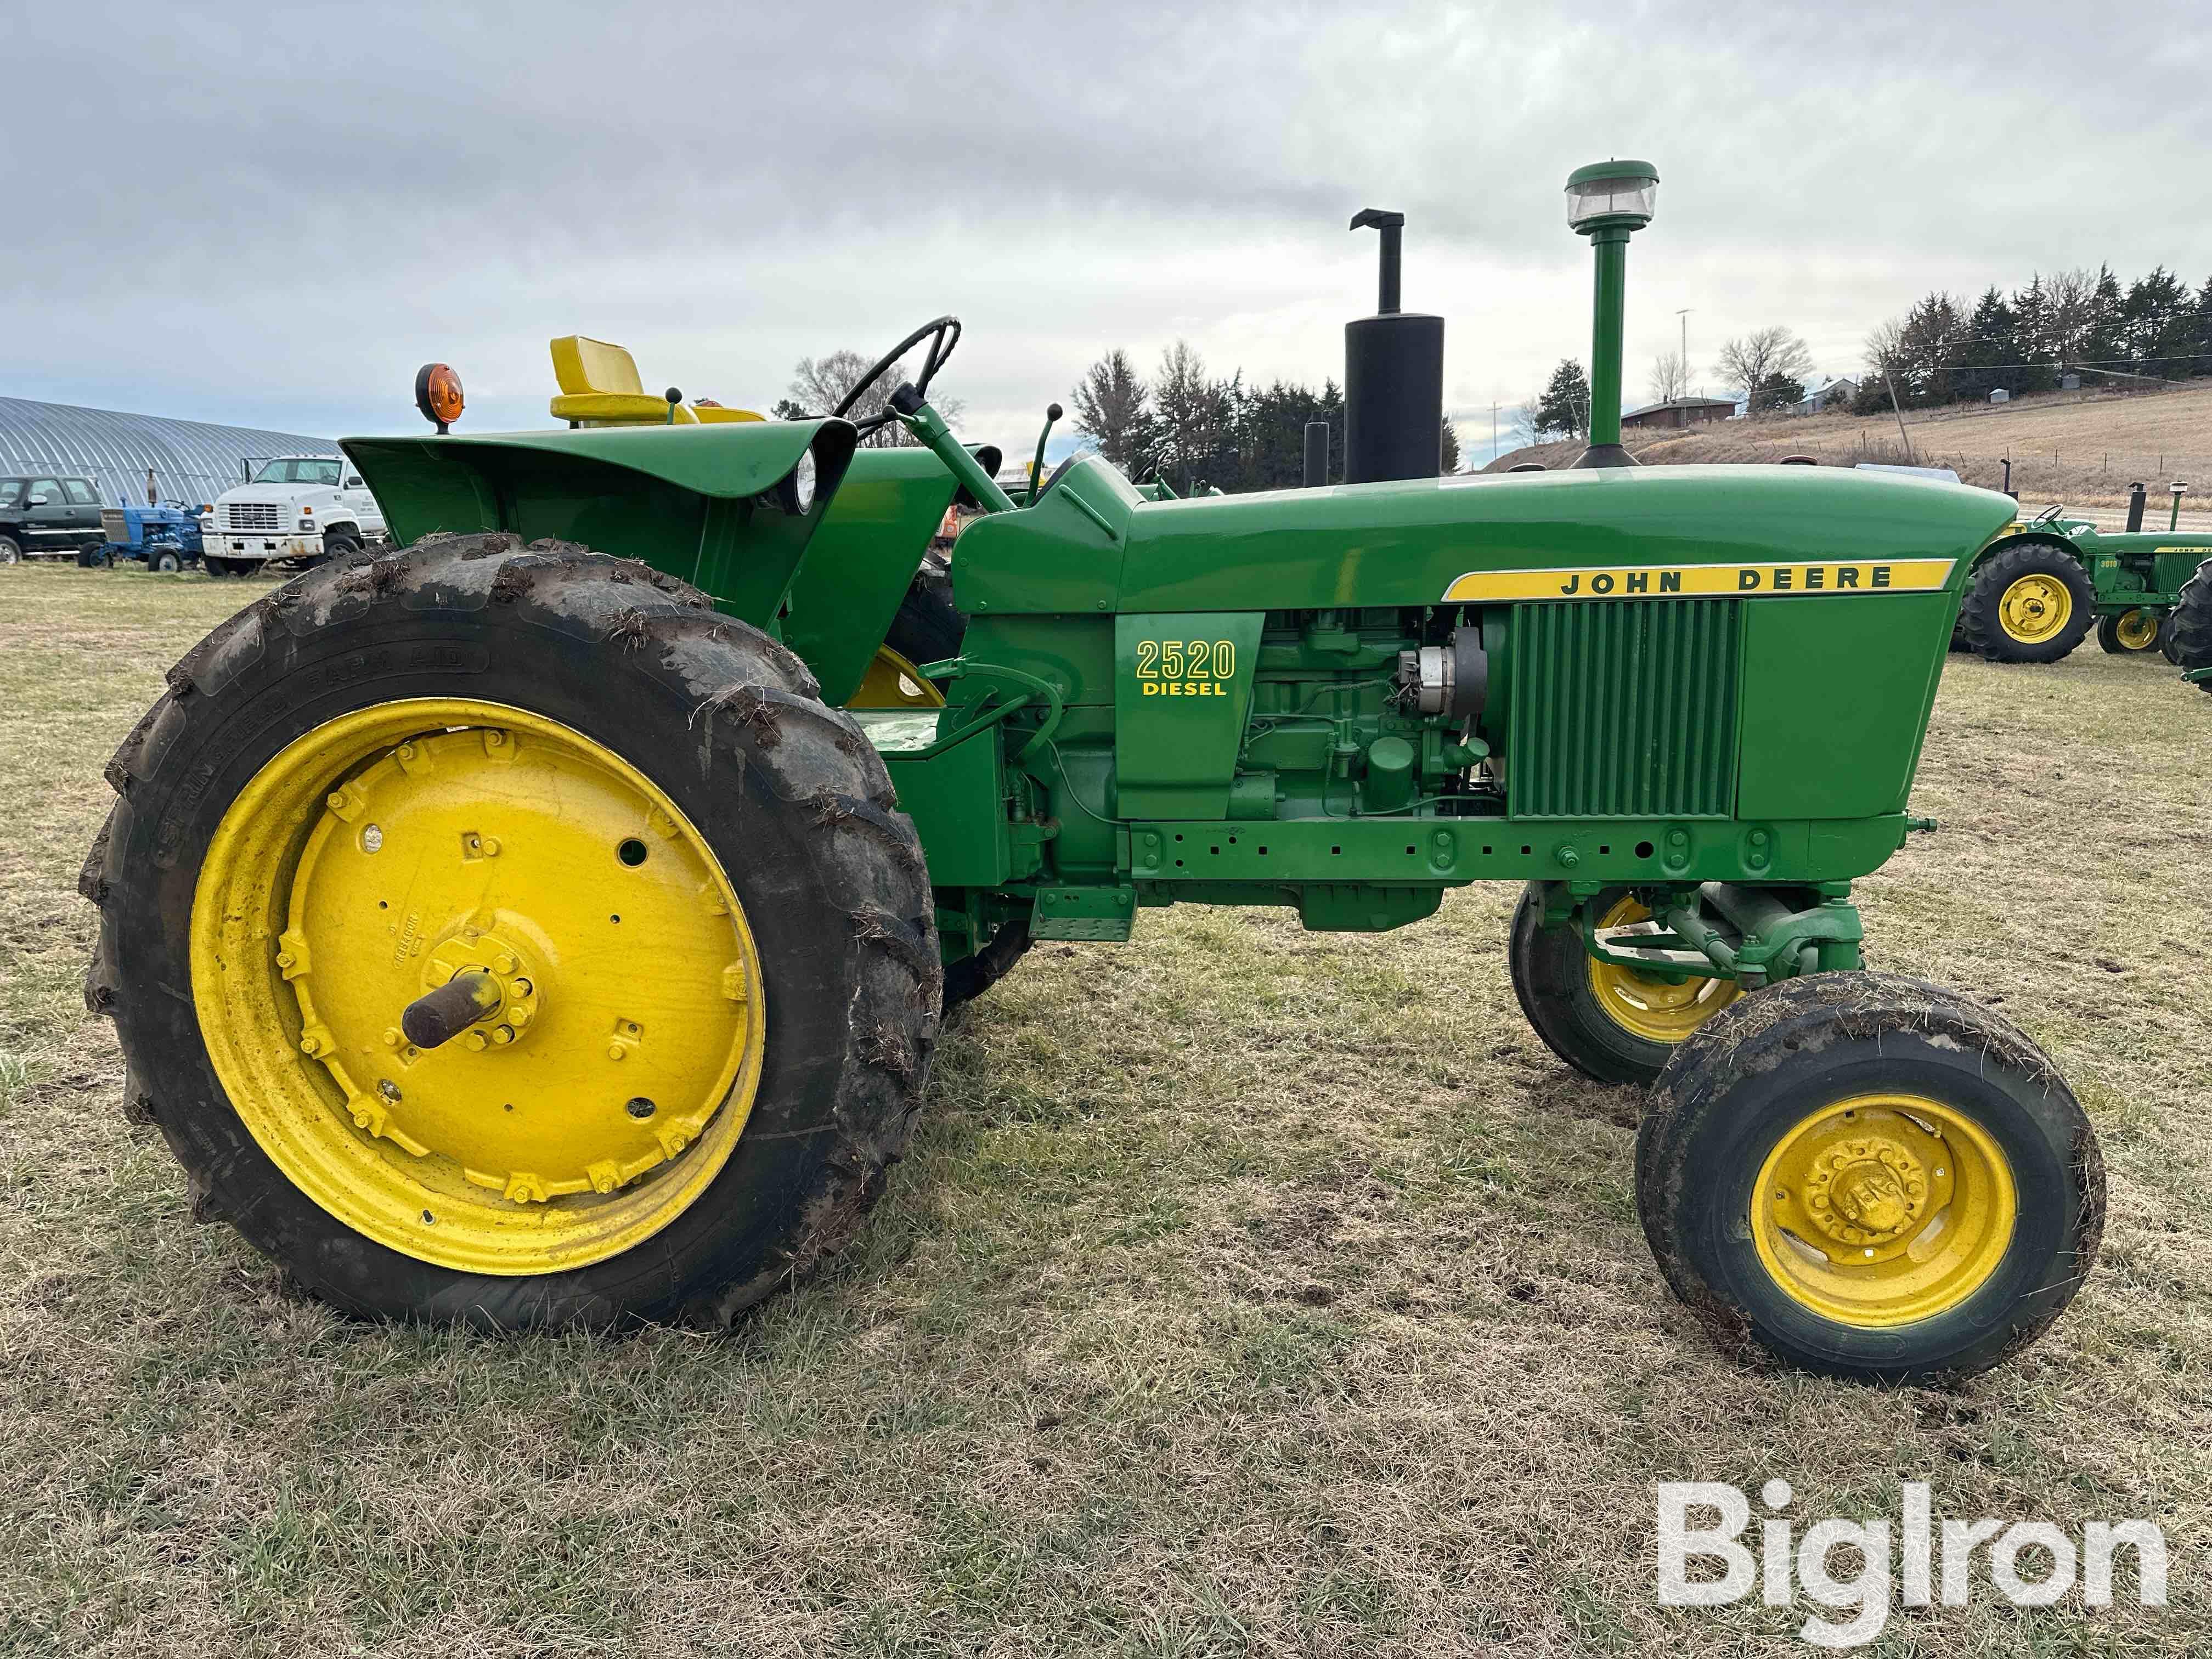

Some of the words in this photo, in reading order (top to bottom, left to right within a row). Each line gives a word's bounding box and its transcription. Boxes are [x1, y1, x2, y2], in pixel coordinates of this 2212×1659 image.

[1560, 571, 1681, 595] JOHN
[1738, 567, 1891, 591] DEERE
[1136, 640, 1235, 679] 2520
[1143, 682, 1227, 696] DIESEL
